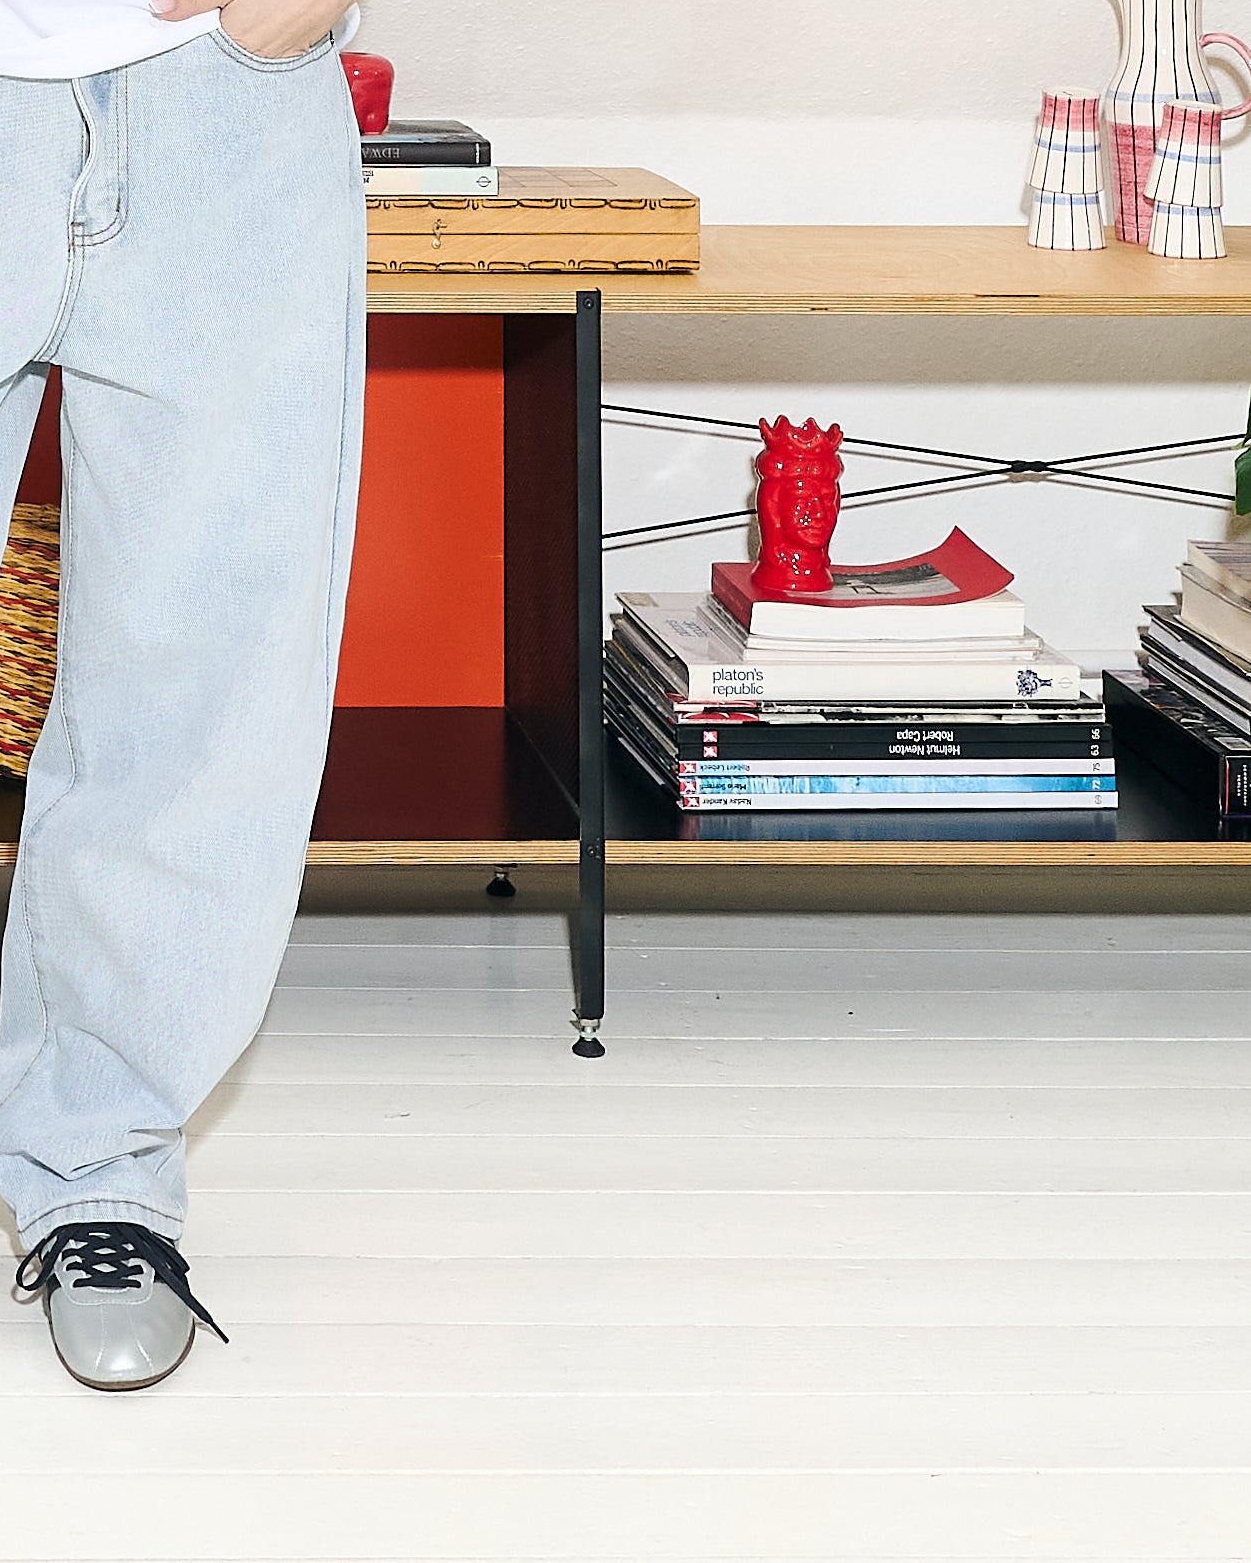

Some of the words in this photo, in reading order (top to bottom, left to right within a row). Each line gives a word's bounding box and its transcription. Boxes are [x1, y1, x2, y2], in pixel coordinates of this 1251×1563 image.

[712, 668, 764, 686] platon's
[712, 683, 764, 697] republic
[896, 728, 921, 743] Capa
[922, 730, 954, 742] Robert
[888, 744, 925, 756] Newton
[926, 744, 961, 756] Helmut
[1090, 744, 1100, 757] 63
